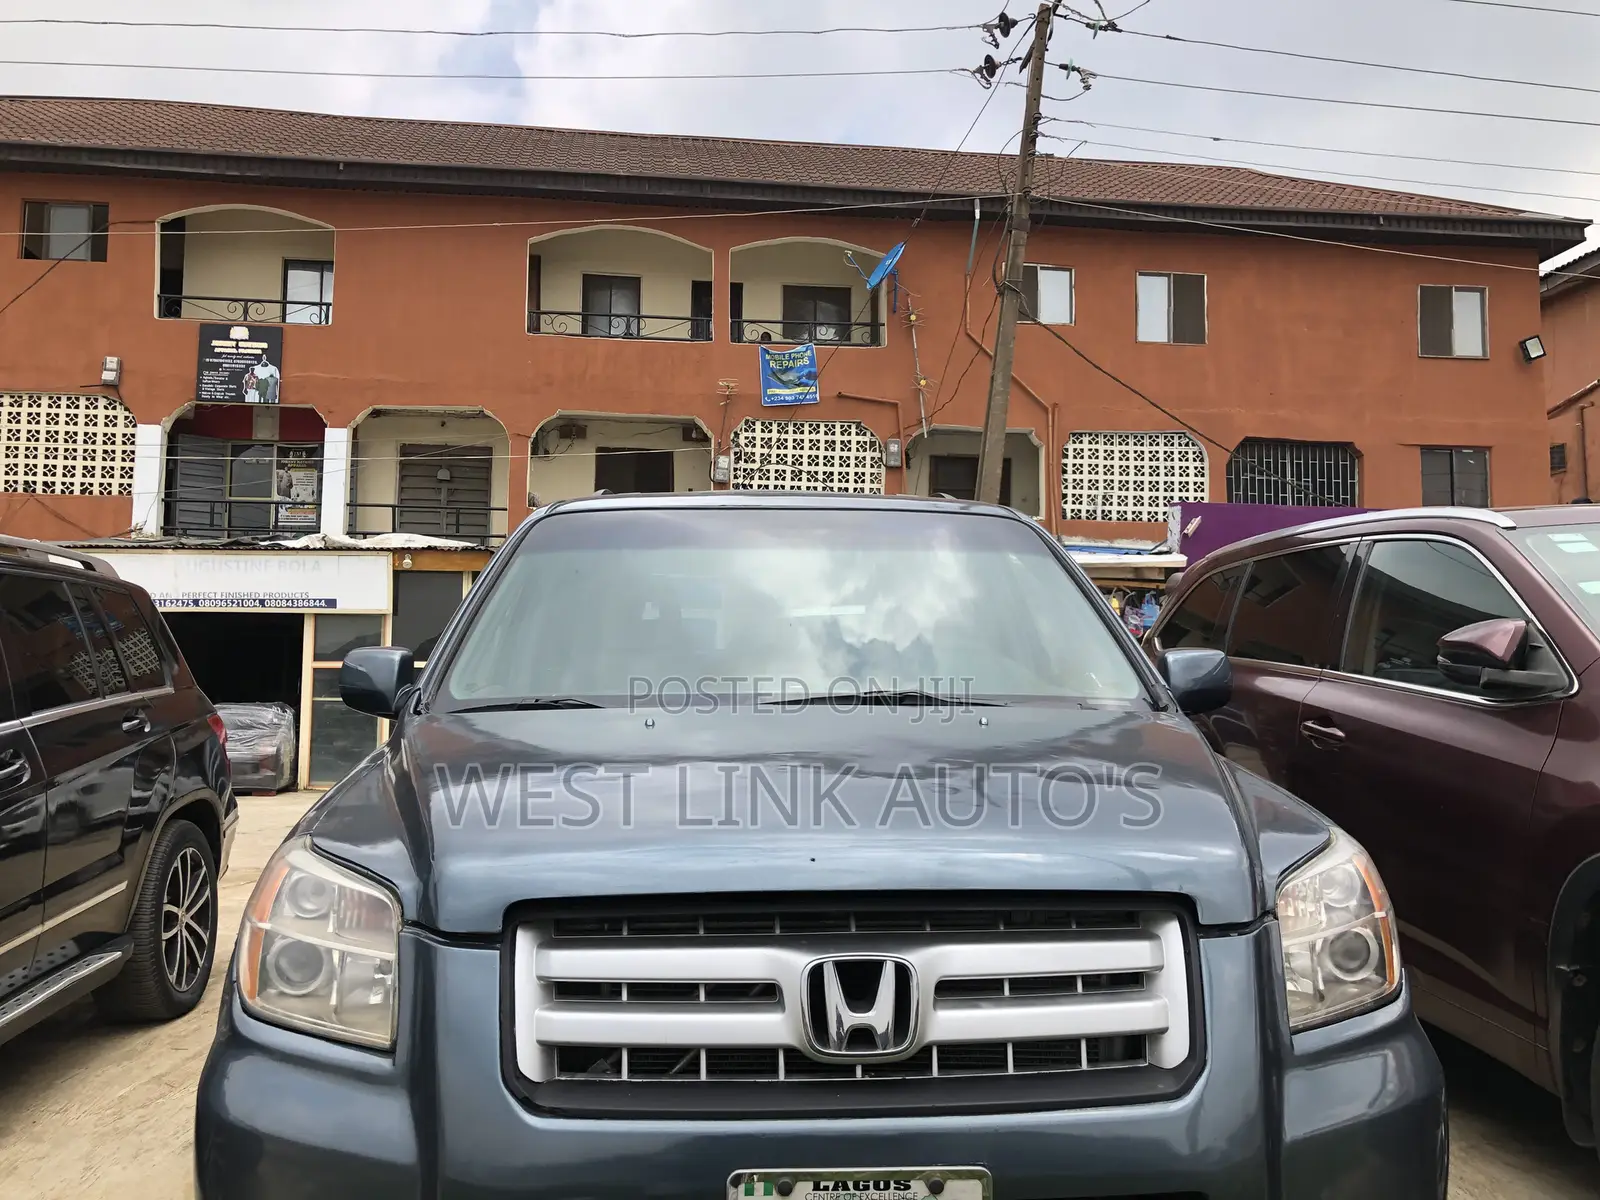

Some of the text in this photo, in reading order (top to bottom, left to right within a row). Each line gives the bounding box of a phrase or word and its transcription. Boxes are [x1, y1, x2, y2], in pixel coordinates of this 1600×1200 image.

[765, 350, 813, 361] MOBILE PHONE
[769, 356, 810, 369] REPAIRS
[182, 558, 275, 574] UGUSTINE
[181, 591, 218, 599] PERFECT
[220, 591, 261, 599] FINISHED
[263, 591, 310, 599] PRODUCTS
[198, 599, 262, 608] 08096521004,
[264, 599, 328, 608] 08084386844.
[812, 1179, 912, 1192] LAGOS
[804, 1192, 841, 1200] CENTRE
[859, 1192, 919, 1200] EXCELLENCE
